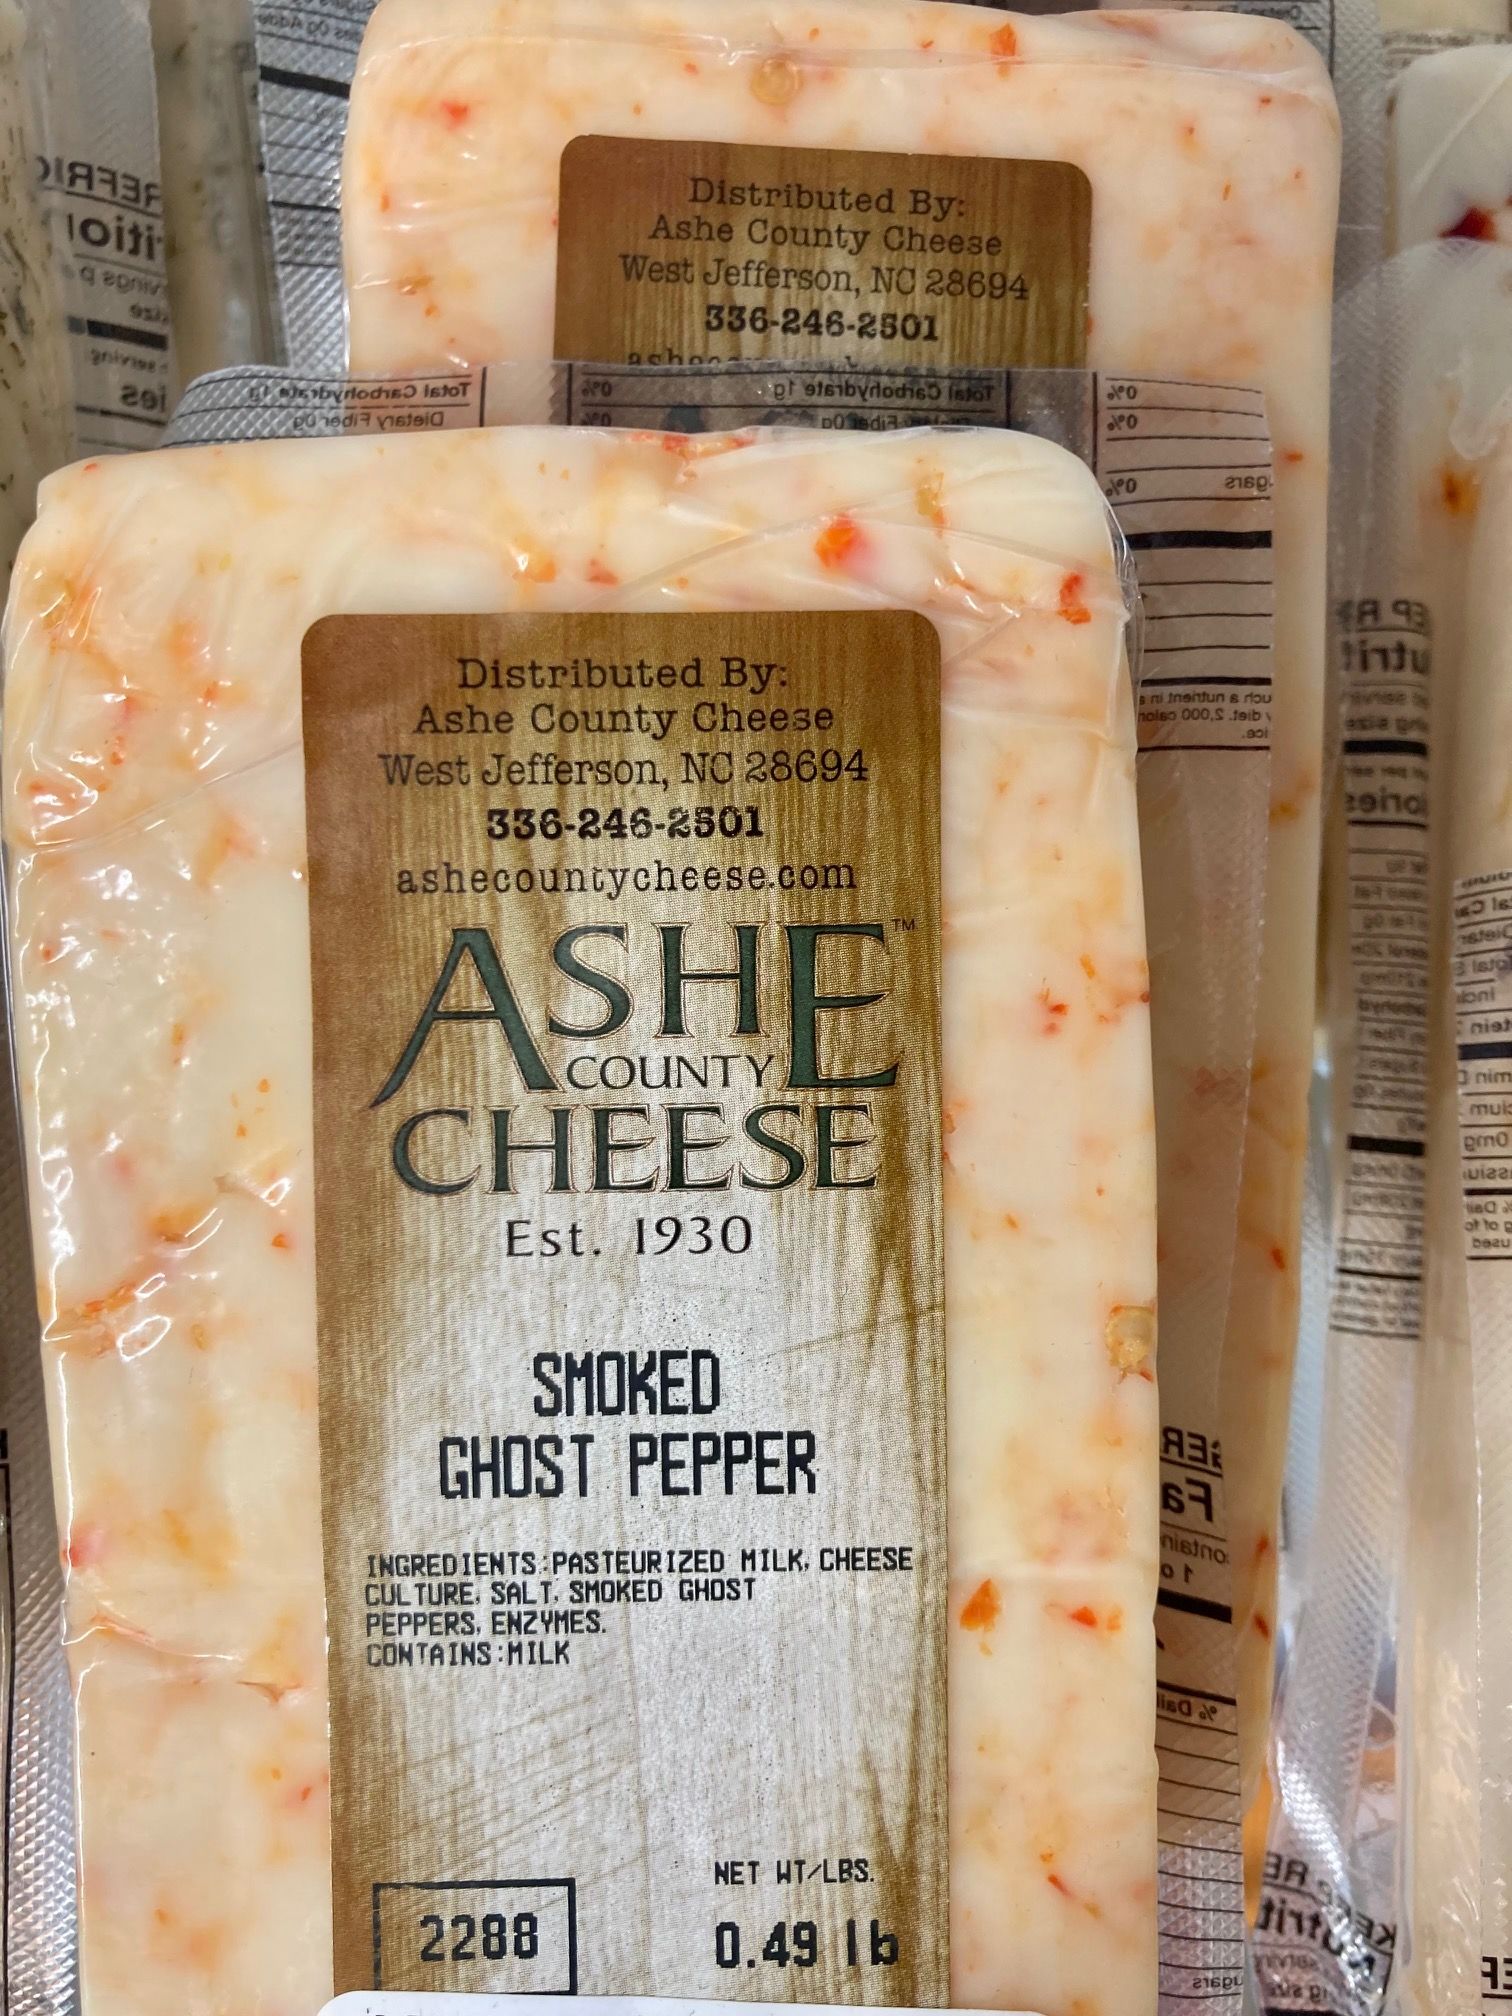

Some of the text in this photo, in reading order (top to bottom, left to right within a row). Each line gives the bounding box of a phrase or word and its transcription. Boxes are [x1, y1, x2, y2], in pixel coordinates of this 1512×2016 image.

[689, 177, 966, 222] Distributed By:
[648, 215, 1002, 256] Ashe County Cheese
[619, 254, 1029, 300] West Jefferson, NC 28694
[705, 305, 939, 342] 336-246-2501
[457, 657, 788, 695] Distributed By:
[414, 702, 834, 740] Ashe County Cheese
[380, 749, 869, 791] West Jefferson, NC 28694
[487, 807, 765, 840] 336-246-2501
[397, 860, 857, 900] ashecountycheese.com
[372, 920, 900, 1107] ASHE
[565, 1054, 775, 1091] COUNTY
[391, 1102, 883, 1195] CHEESE
[506, 1214, 752, 1258] Est. 1930
[532, 1349, 722, 1418] SMOKED
[438, 1429, 818, 1500] GHOST PEPPER
[740, 1548, 809, 1575] MILK,
[819, 1546, 914, 1573] CHEESE
[364, 1577, 757, 1607] CULTURE, SALT, SMOKED GHOST
[366, 1608, 607, 1638] PEPPERS, ENZYMES.
[715, 1857, 875, 1886] NET WT/LBS.
[419, 1911, 540, 1962] 2288
[714, 1918, 899, 1969] 0.49 lb
